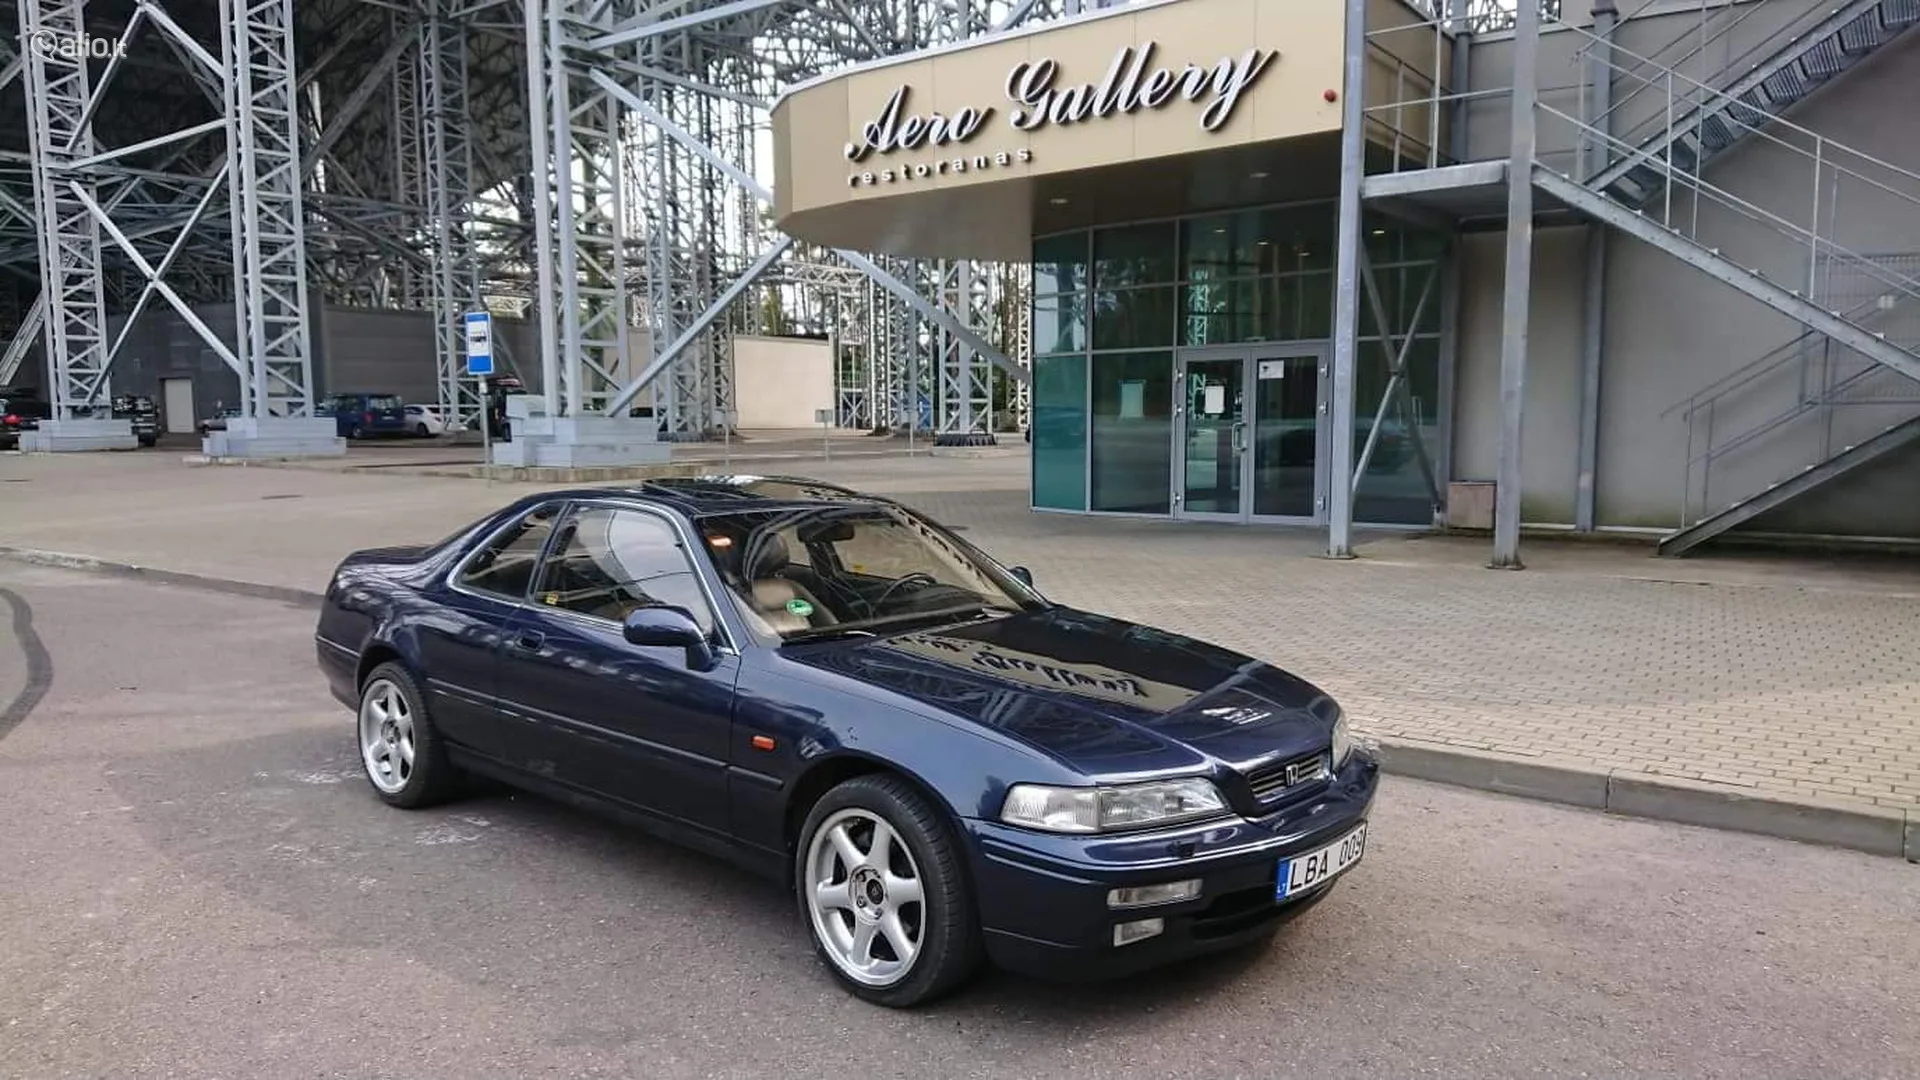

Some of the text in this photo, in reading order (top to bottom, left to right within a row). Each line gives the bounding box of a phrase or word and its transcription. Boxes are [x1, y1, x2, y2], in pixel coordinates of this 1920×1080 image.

[844, 40, 1279, 161] Aero Gallery
[847, 146, 1034, 187] restoranas
[1290, 848, 1328, 890] LBA
